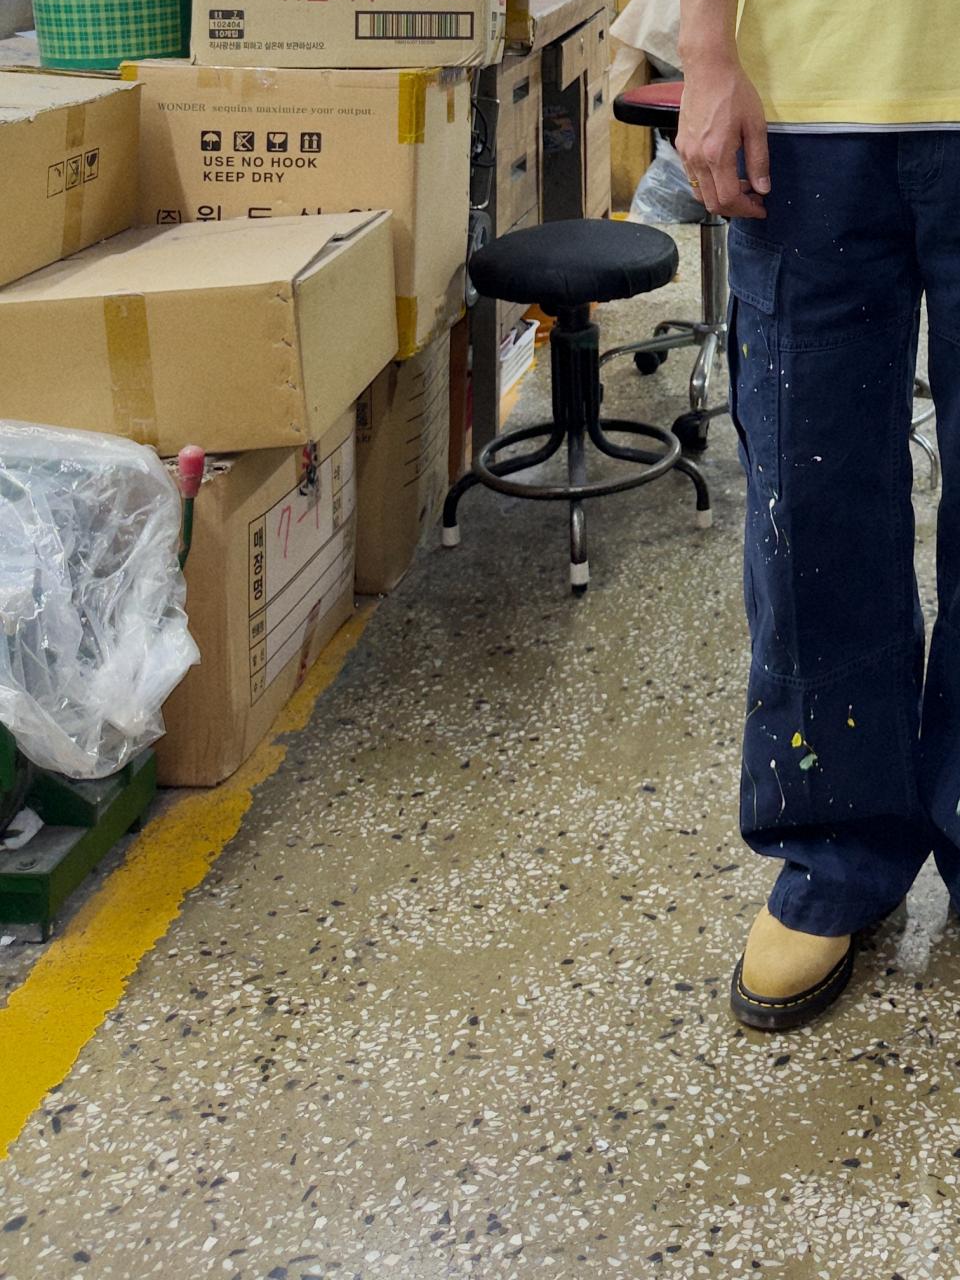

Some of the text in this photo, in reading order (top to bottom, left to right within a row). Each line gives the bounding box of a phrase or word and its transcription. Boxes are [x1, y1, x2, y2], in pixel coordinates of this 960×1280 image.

[157, 102, 206, 112] WONDER
[212, 104, 252, 115] sequins
[256, 105, 307, 114] maximize
[311, 106, 334, 116] your
[203, 156, 318, 169] USE NO HOOK
[203, 171, 285, 183] KEEP DRY
